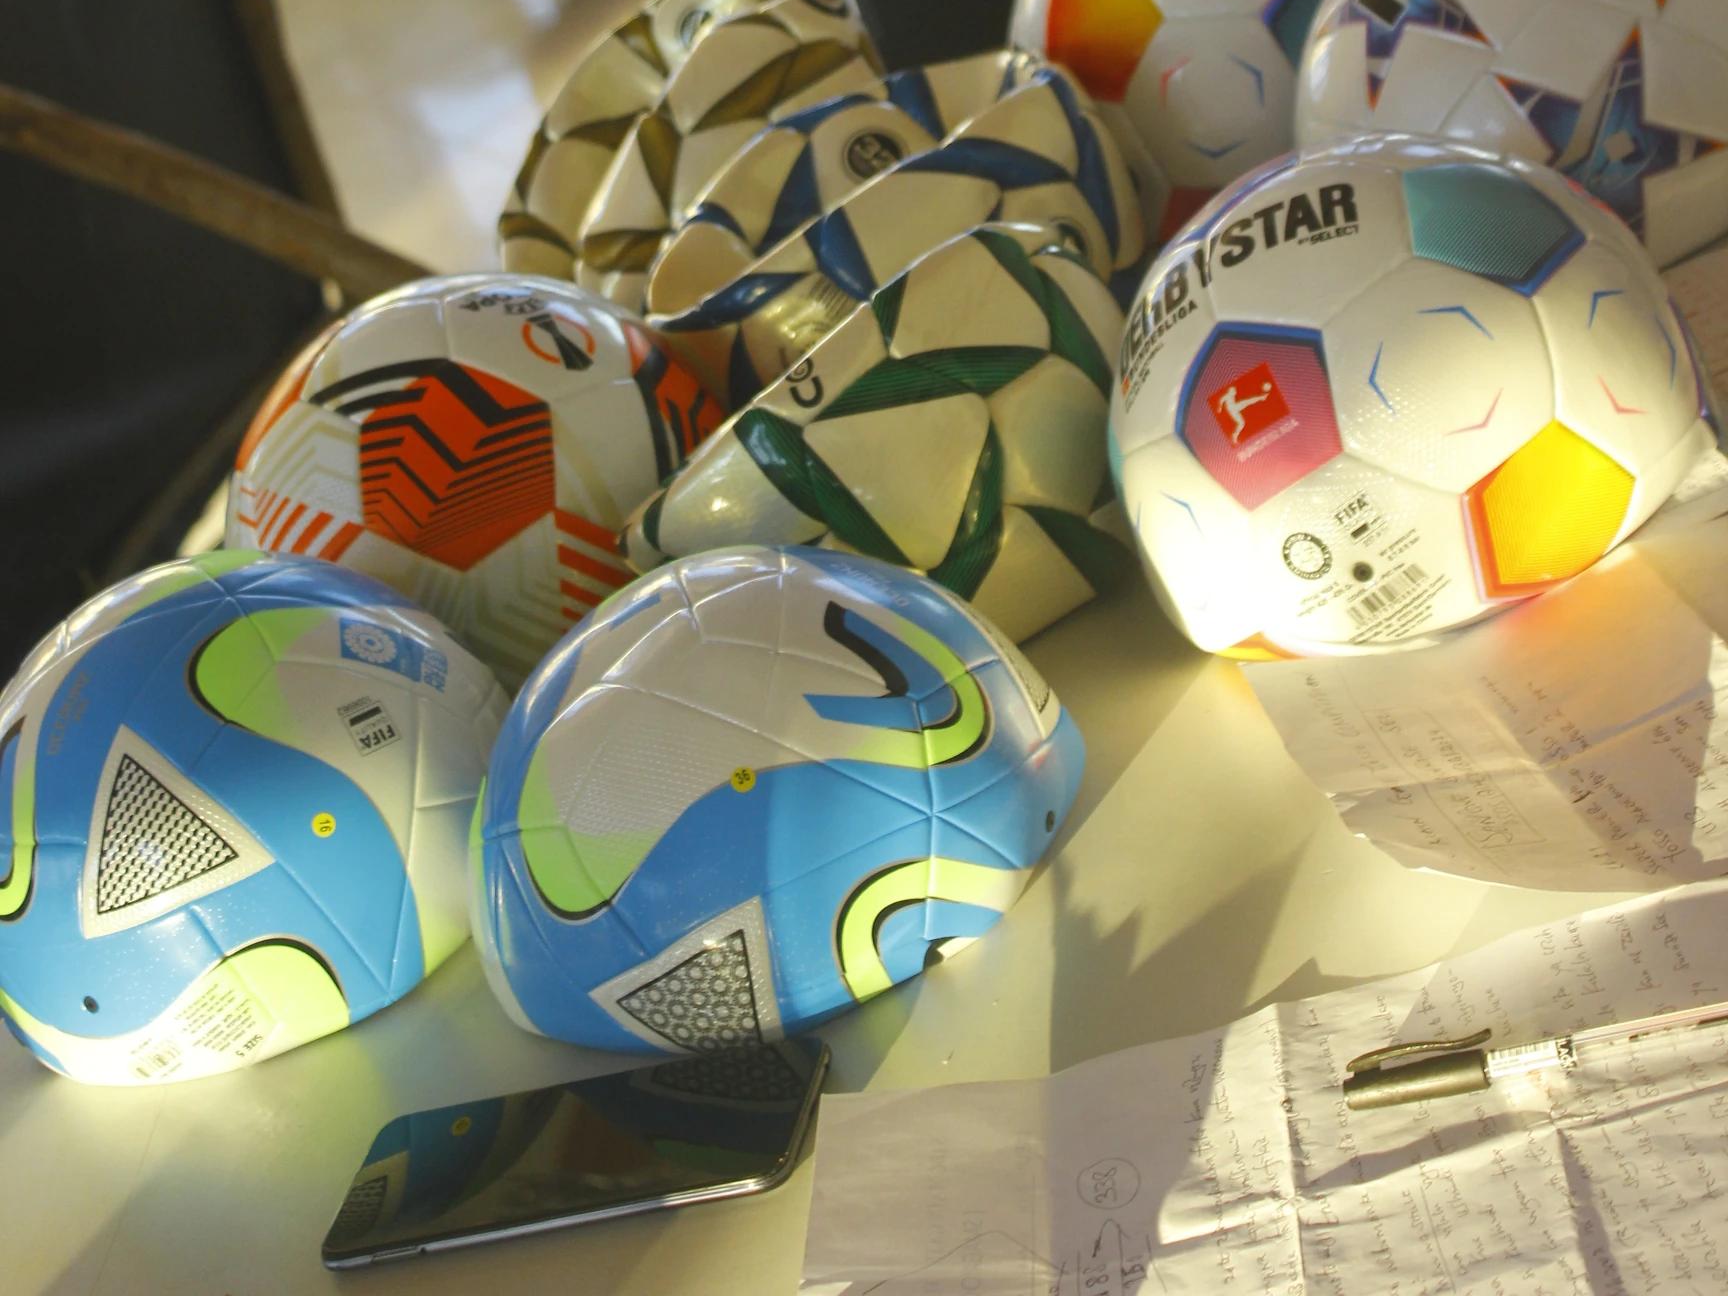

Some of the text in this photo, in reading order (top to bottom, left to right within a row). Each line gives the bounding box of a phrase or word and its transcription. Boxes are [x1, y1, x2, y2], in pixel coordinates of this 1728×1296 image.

[1309, 222, 1361, 245] SELECT
[1333, 495, 1368, 524] FIFA
[357, 723, 395, 750] FIFA
[318, 818, 332, 833] 16
[243, 1033, 263, 1051] SIZE
[1091, 1166, 1117, 1203] 338
